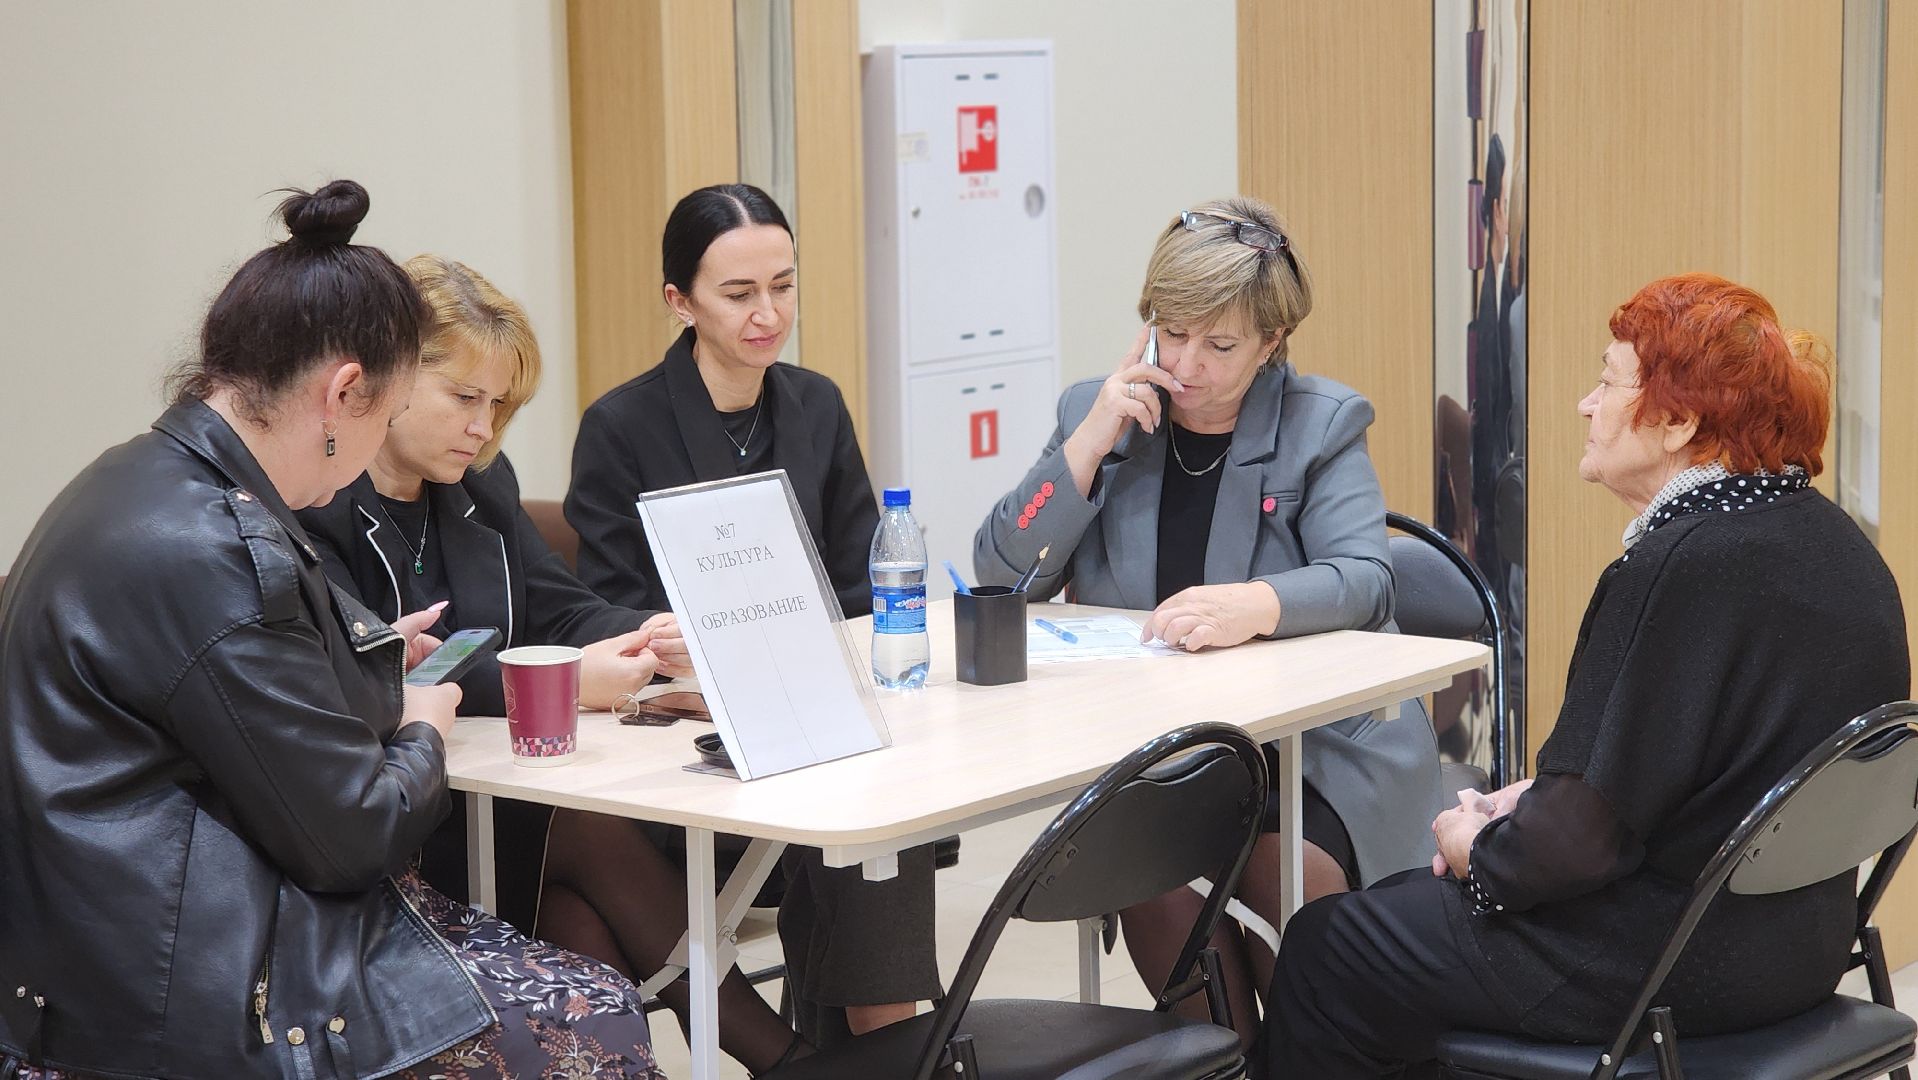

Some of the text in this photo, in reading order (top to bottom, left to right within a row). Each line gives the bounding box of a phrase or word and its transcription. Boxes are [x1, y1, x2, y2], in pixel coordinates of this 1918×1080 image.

[715, 523, 736, 540] №7
[696, 545, 774, 573] КУЛЬТУРА
[701, 595, 808, 630] ОБРАЗОВАНИЕ
